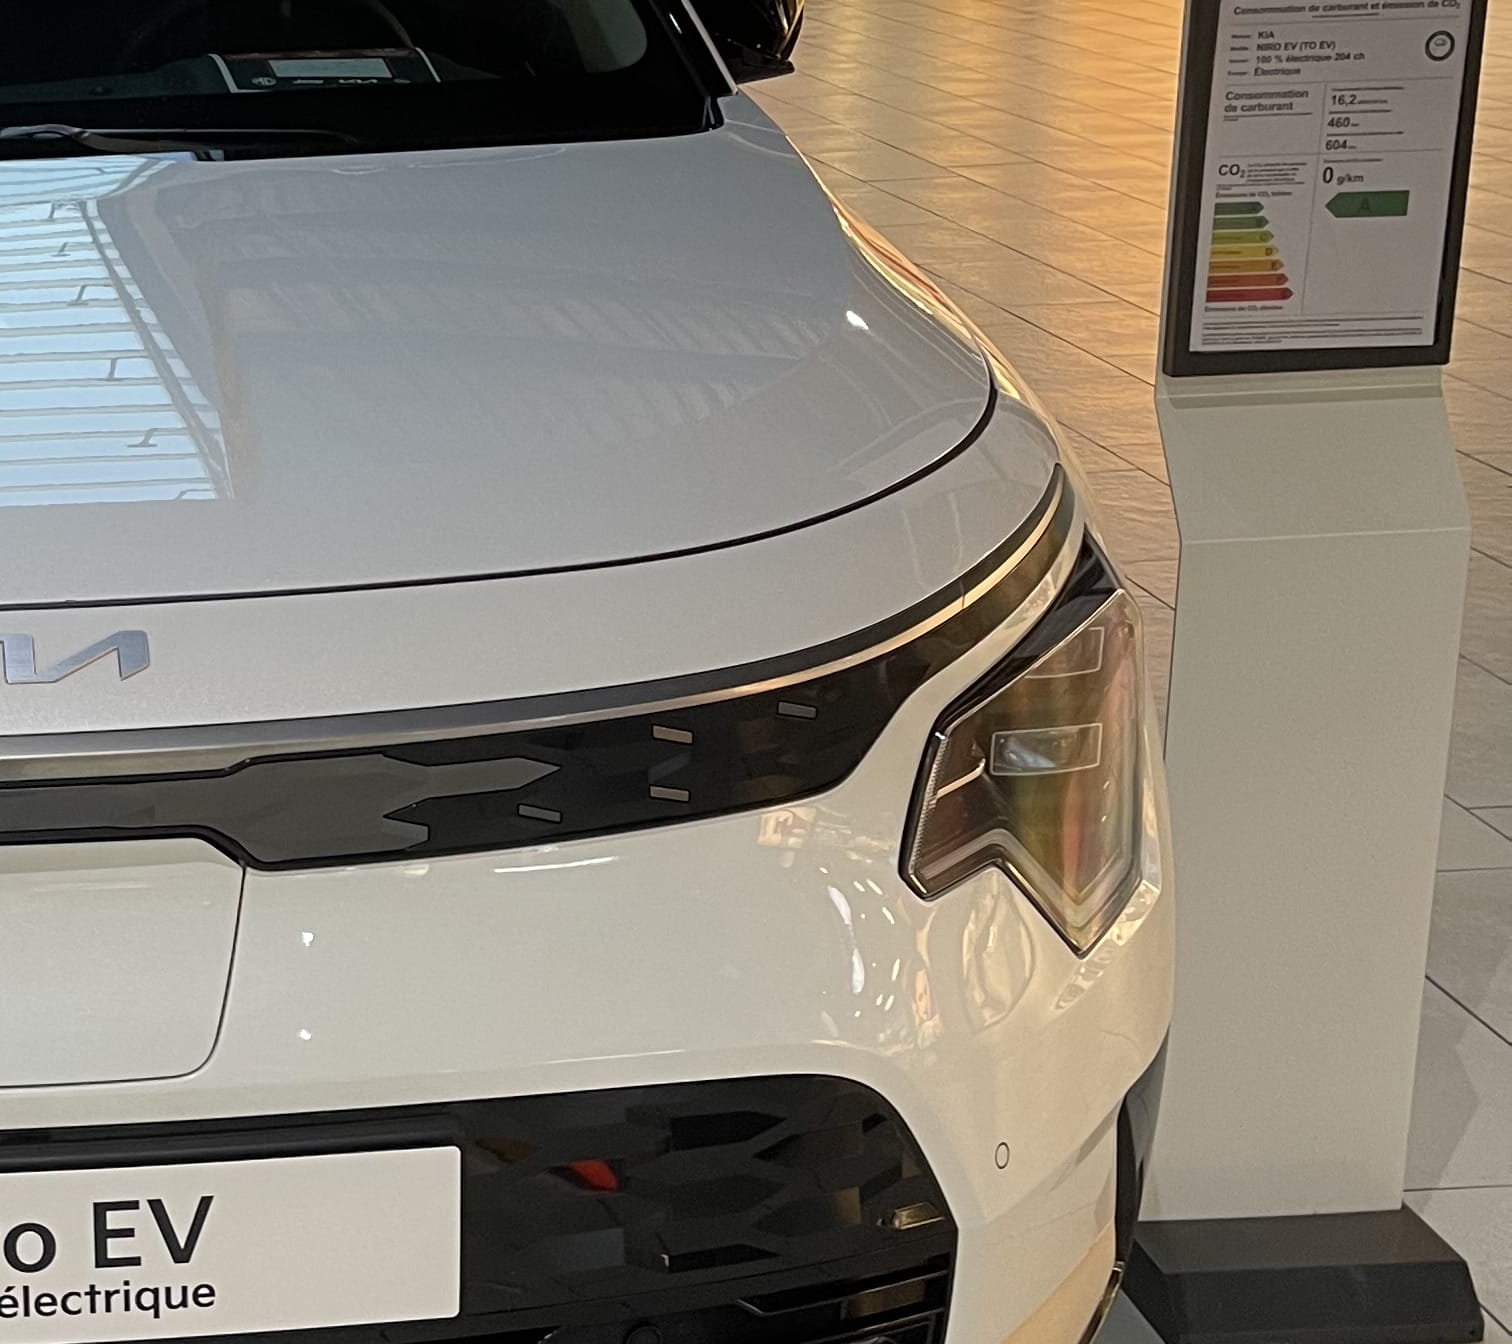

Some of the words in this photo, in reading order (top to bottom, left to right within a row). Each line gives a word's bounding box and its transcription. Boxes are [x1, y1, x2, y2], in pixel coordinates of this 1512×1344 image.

[1258, 31, 1275, 40] KIA
[1284, 42, 1299, 52] EV
[1225, 90, 1308, 101] Consommation
[1331, 94, 1357, 107] 16,2
[1224, 104, 1238, 113] de
[1241, 102, 1293, 113] carburant
[1328, 117, 1350, 128] 460
[1325, 139, 1348, 150] 604
[1218, 164, 1246, 178] CO2
[1322, 166, 1334, 184] 0
[1337, 174, 1364, 185] g/km
[1360, 197, 1373, 213] A
[92, 1195, 215, 1269] EV
